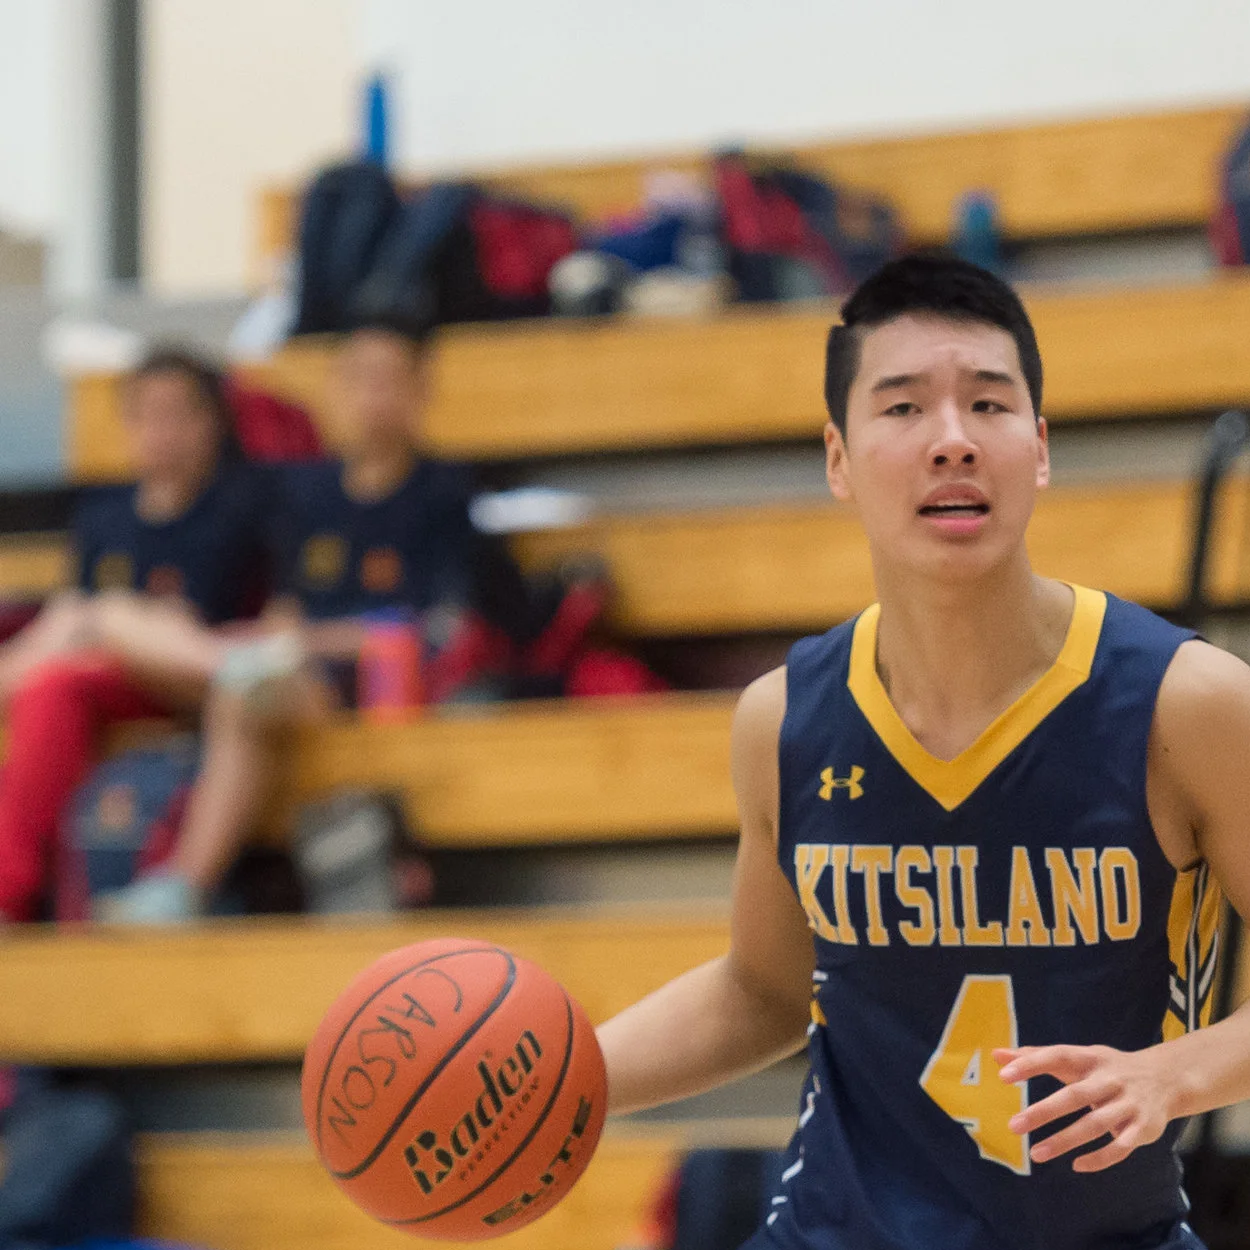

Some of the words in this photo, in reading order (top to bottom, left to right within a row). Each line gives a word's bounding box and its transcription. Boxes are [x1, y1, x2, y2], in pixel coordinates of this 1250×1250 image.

[795, 843, 1142, 947] KITSILANO
[328, 968, 463, 1146] CARSON
[403, 1029, 543, 1195] Baden
[918, 973, 1032, 1177] 4
[481, 1095, 593, 1226] ELITE
